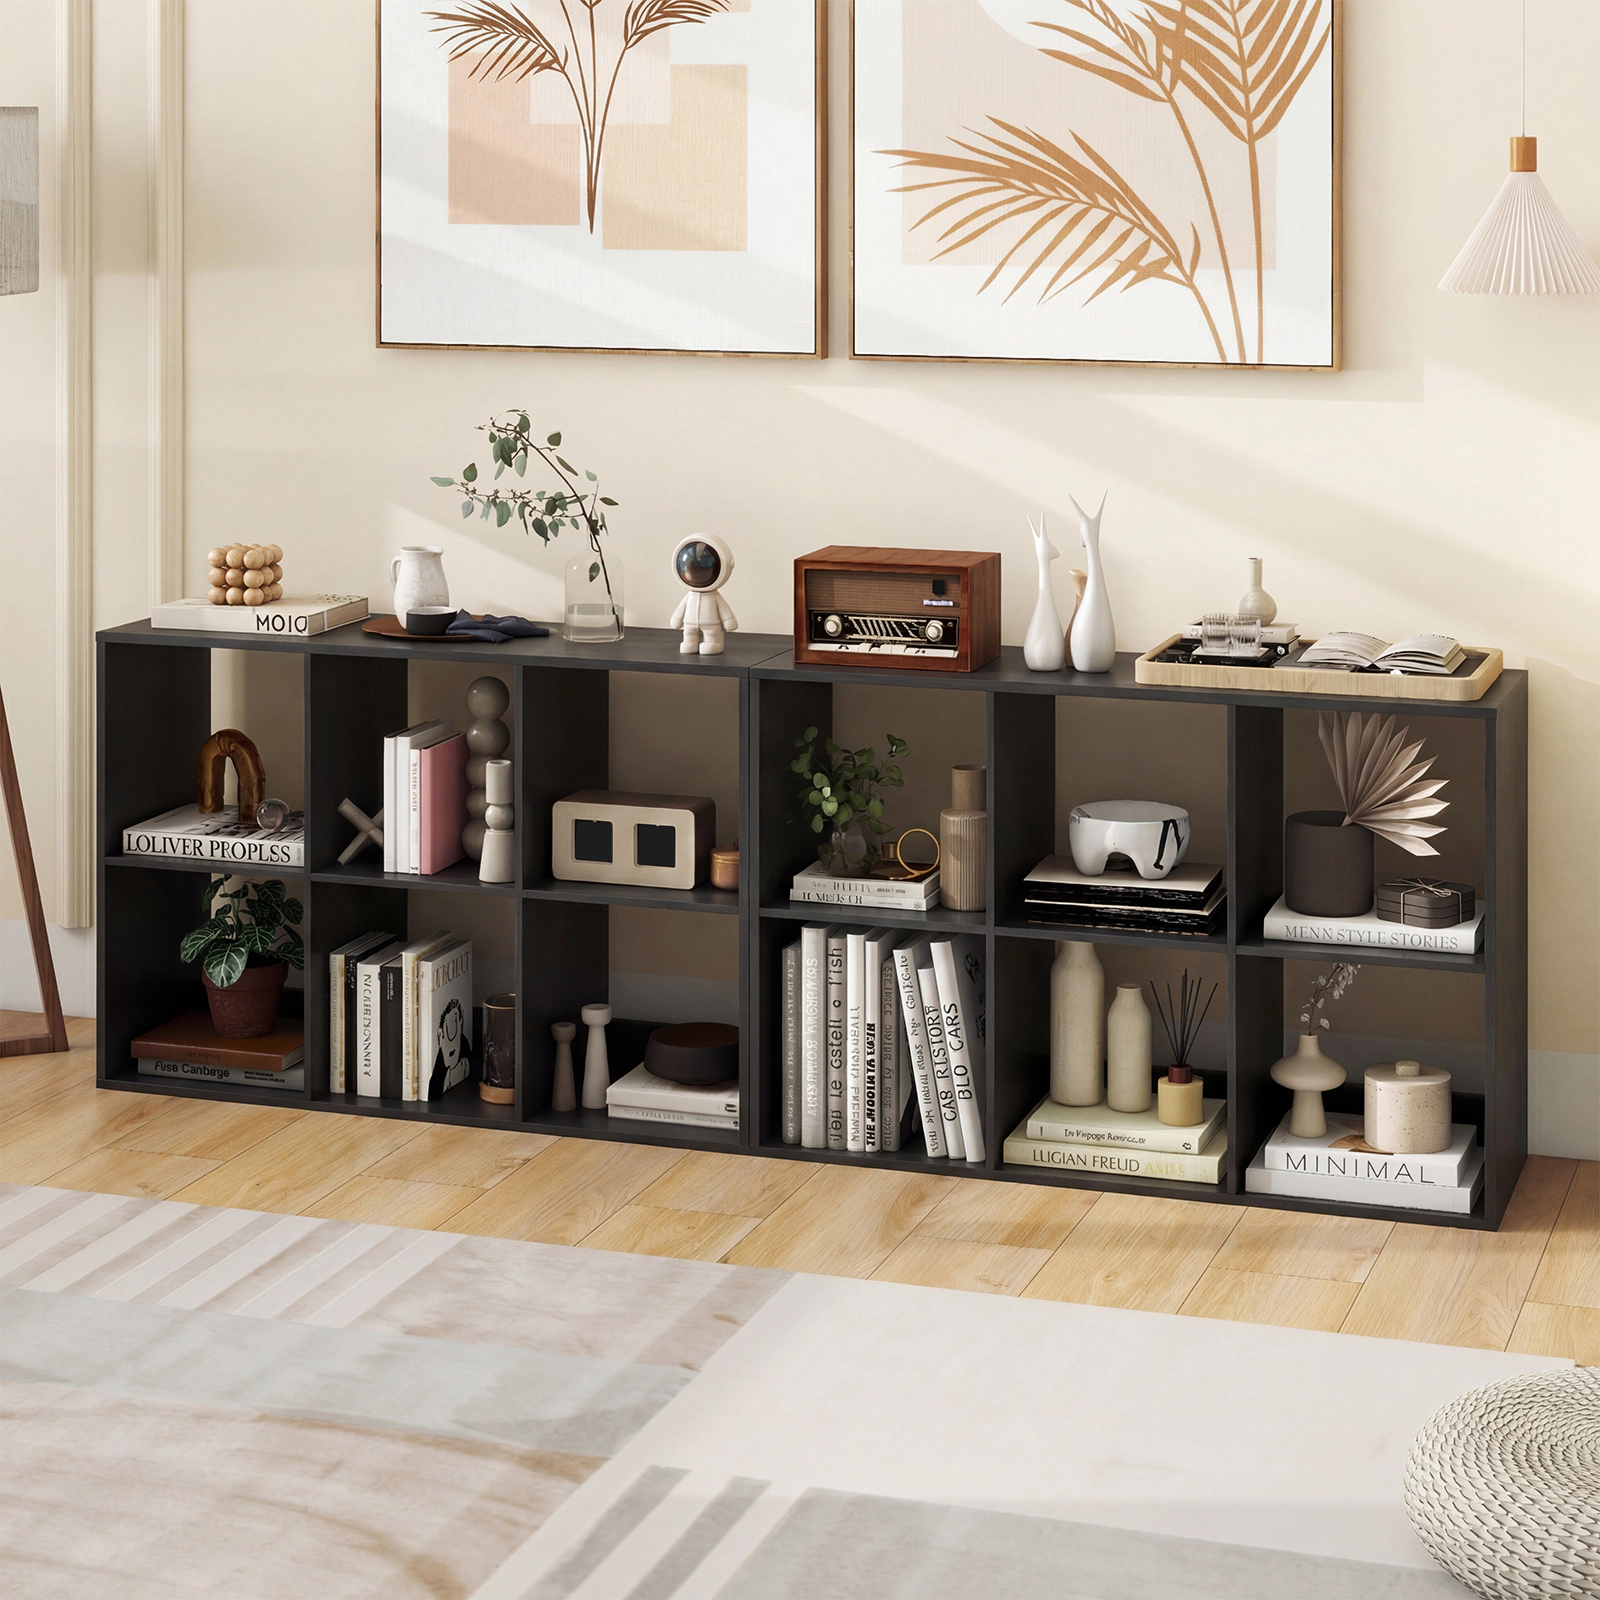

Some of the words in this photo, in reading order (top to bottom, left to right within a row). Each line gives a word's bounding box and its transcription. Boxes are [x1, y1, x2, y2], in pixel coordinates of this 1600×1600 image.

[126, 833, 203, 857] LOLIVER
[209, 840, 291, 863] PROPLSS
[1284, 924, 1333, 940] MENN
[1336, 927, 1386, 945] STYLE
[1390, 931, 1459, 951] STORIES
[943, 1003, 965, 1052] CARS
[1092, 1155, 1140, 1172] FREUD
[1286, 1152, 1435, 1184] MINIMAL
